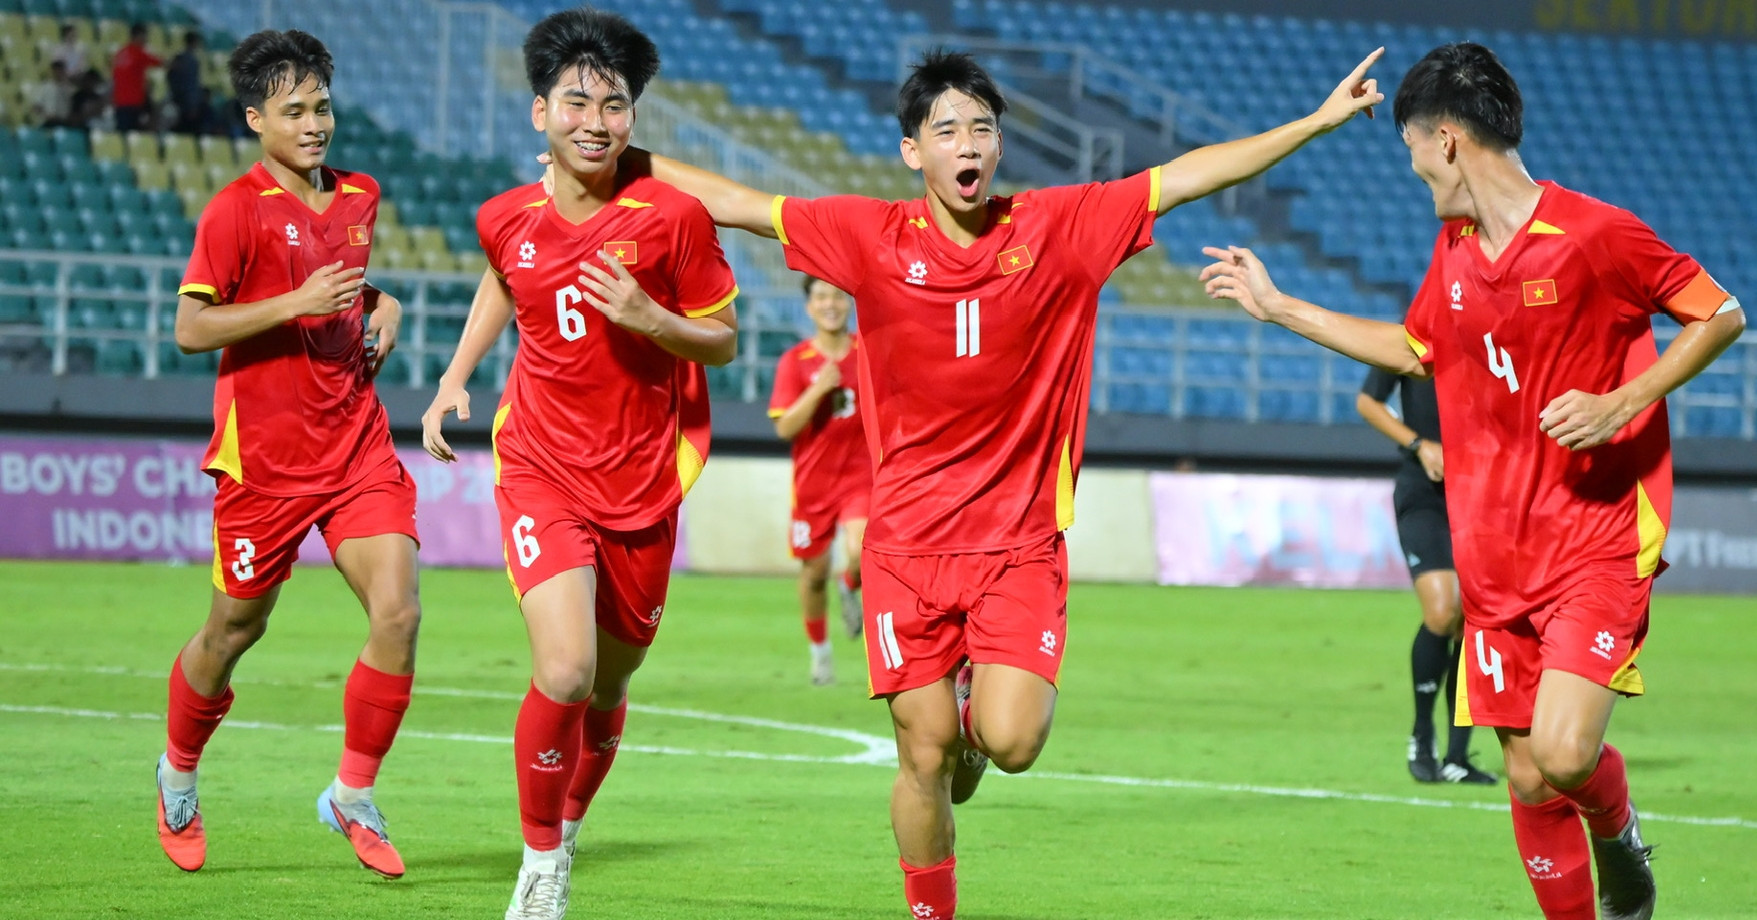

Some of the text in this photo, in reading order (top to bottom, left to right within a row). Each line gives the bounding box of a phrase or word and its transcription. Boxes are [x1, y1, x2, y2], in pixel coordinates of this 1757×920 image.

[556, 284, 587, 342] 6
[956, 298, 980, 358] 11
[1483, 331, 1520, 394] 4
[1, 453, 126, 497] BOYS'
[231, 538, 256, 581] 3
[512, 514, 542, 569] 6
[876, 611, 904, 670] 11
[1475, 630, 1505, 694] 4
